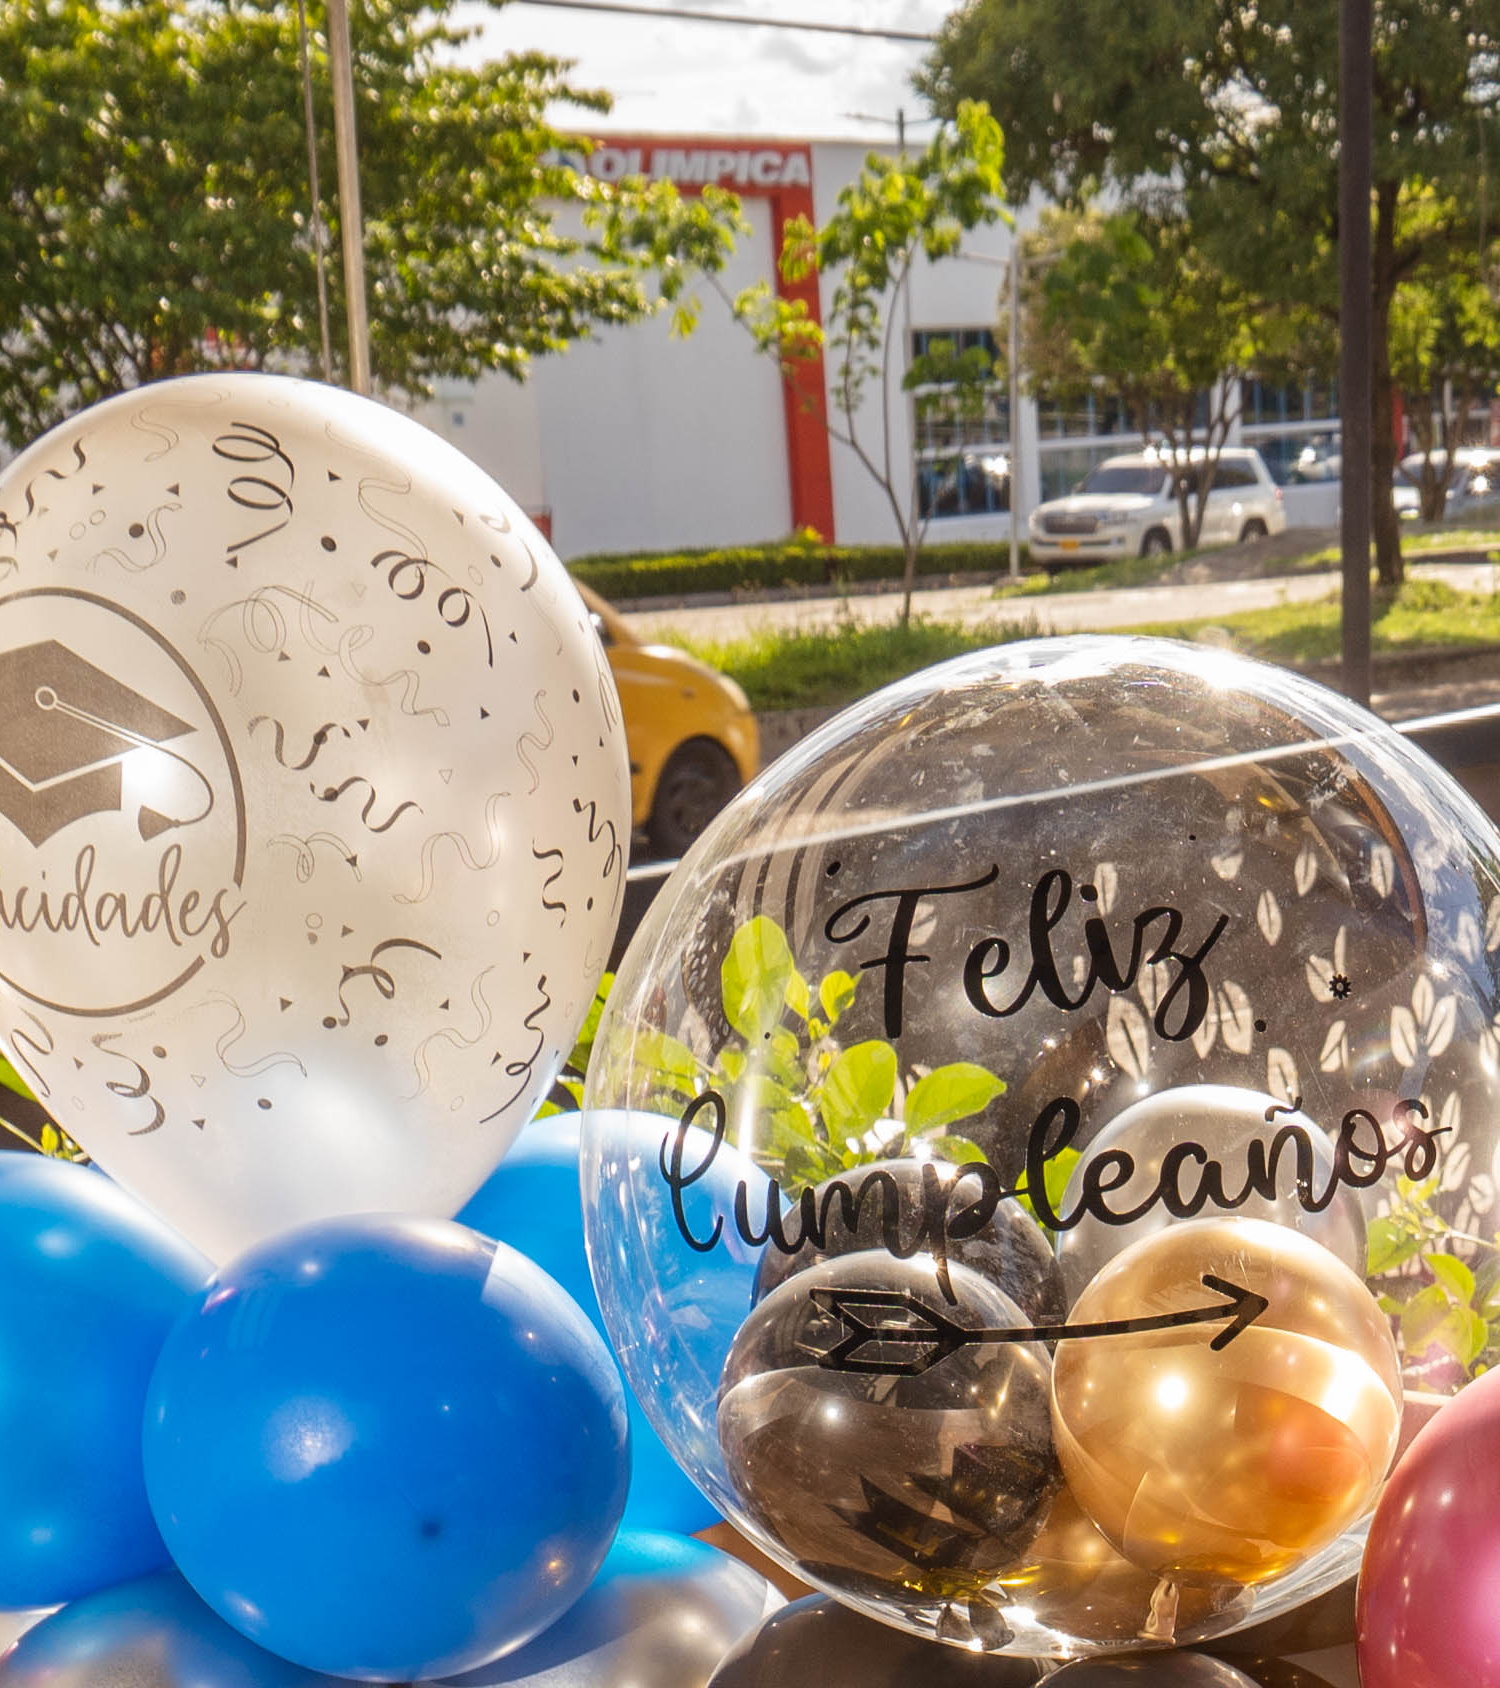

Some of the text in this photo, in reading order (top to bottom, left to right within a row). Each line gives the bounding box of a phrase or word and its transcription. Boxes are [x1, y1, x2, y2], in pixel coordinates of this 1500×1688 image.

[589, 147, 812, 185] OLIMPICA
[823, 863, 1229, 1041] Feliz
[659, 1089, 1453, 1306] Cumpleaños
